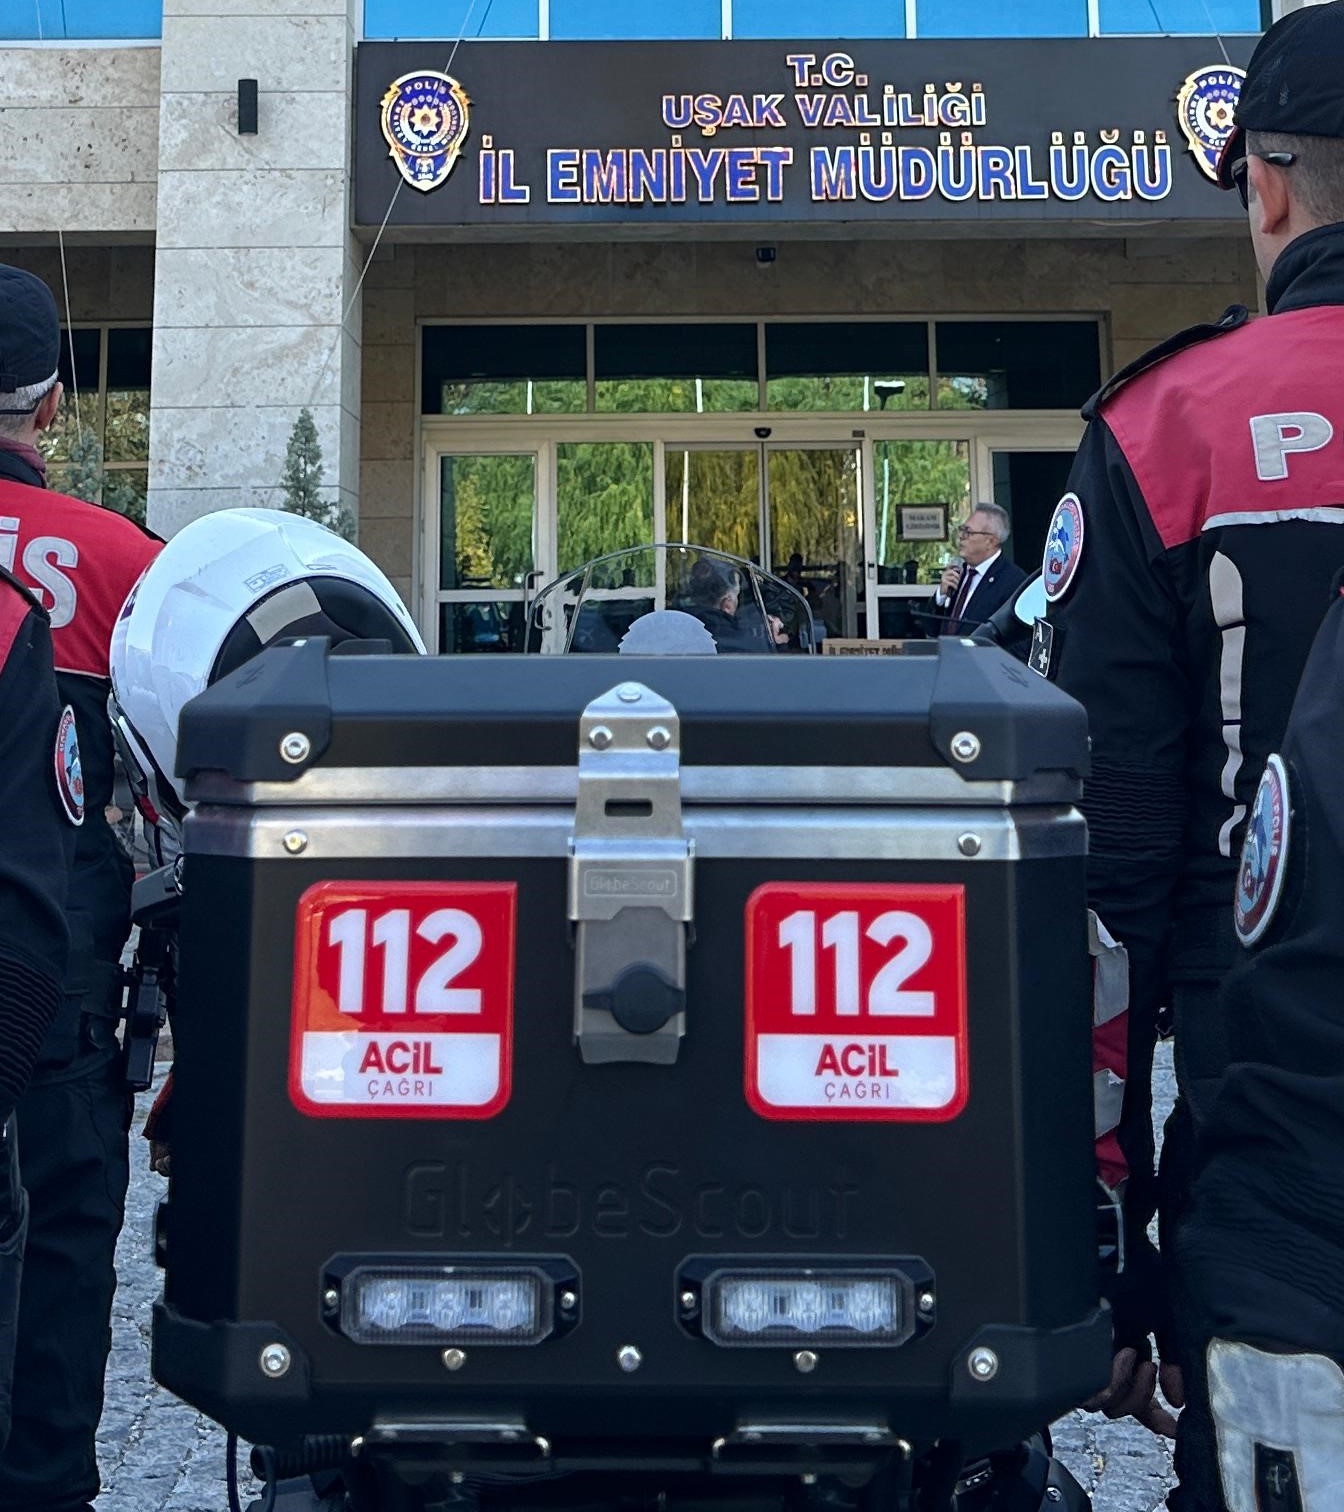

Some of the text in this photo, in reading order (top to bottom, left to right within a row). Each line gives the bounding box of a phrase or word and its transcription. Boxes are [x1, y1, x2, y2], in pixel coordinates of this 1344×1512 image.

[786, 52, 869, 88] T.C.
[662, 81, 988, 136] UŞAK VALİLİĞİ
[478, 127, 1174, 205] İL EMNİYET MÜDÜRLÜĞÜ
[328, 908, 482, 1015] 112
[778, 910, 936, 1017] 112
[358, 1040, 443, 1075] ACİL
[814, 1042, 899, 1078] ACİL
[367, 1076, 435, 1102] ÇAĞRI
[823, 1079, 892, 1105] ÇAĞRI
